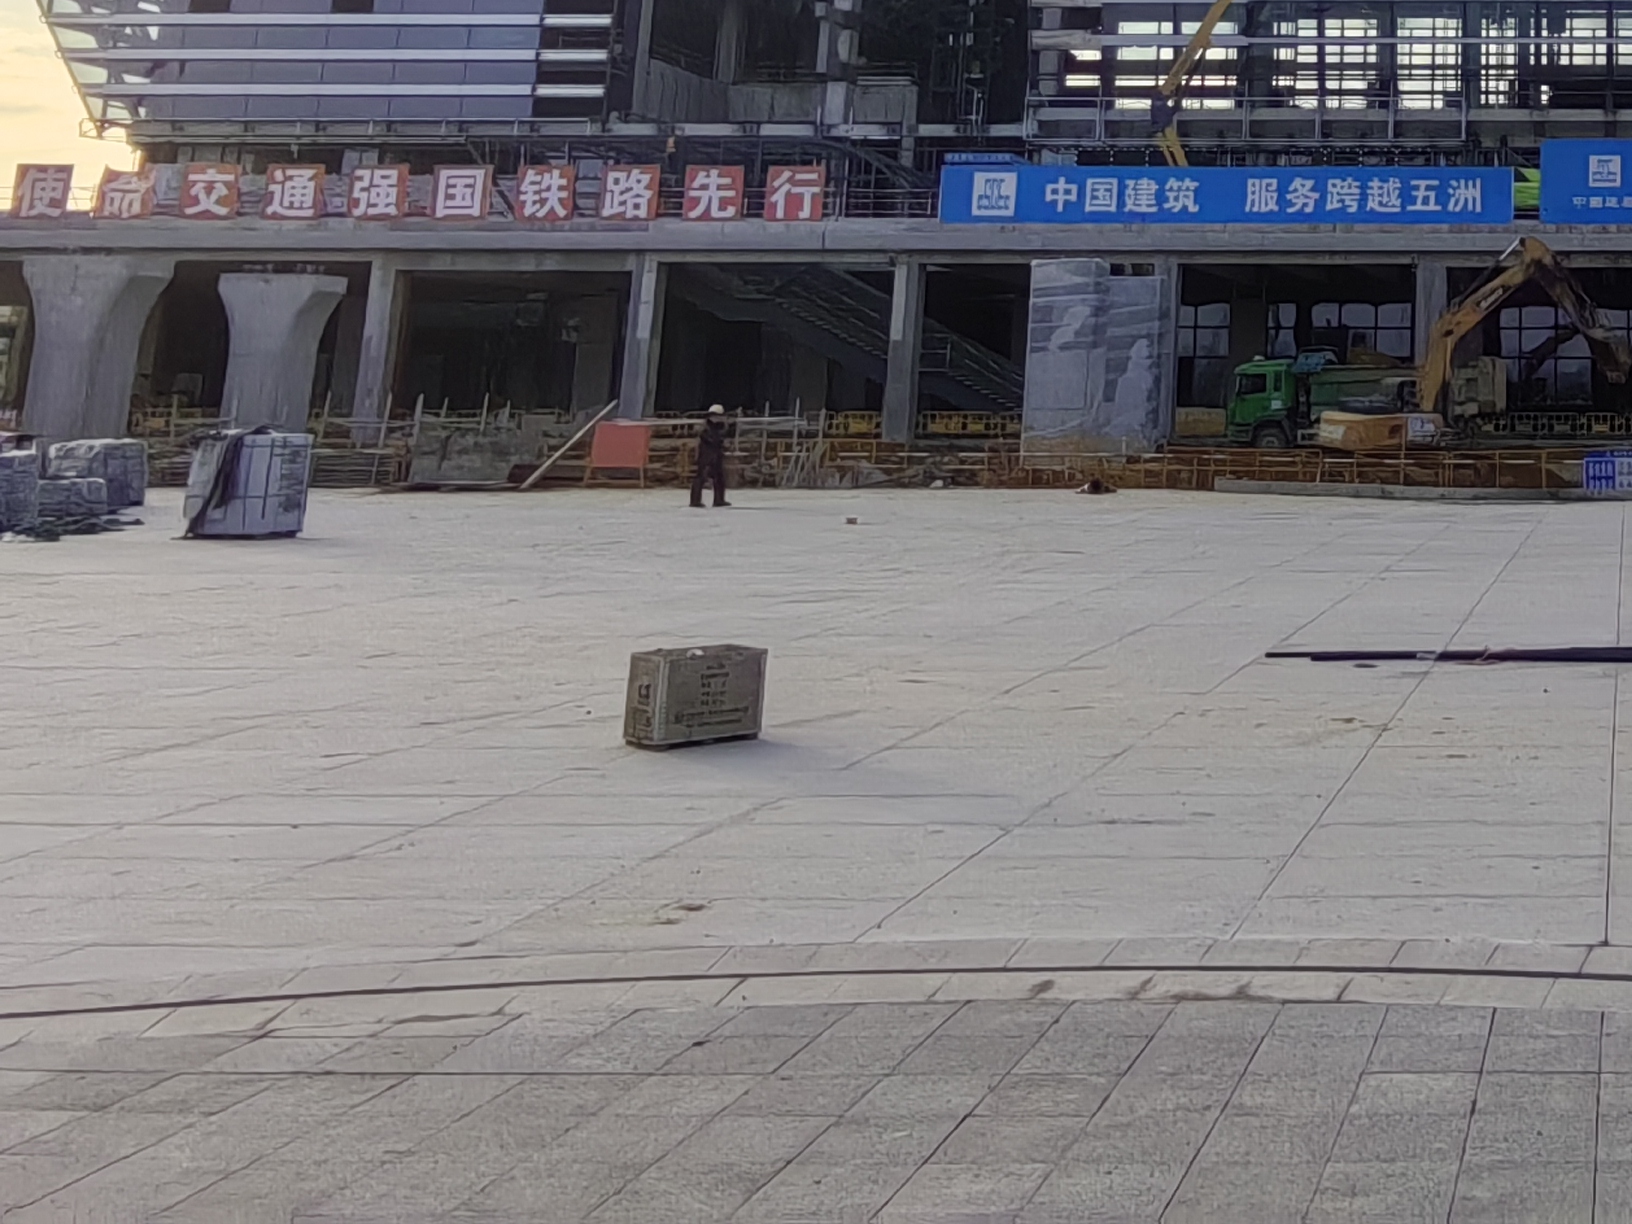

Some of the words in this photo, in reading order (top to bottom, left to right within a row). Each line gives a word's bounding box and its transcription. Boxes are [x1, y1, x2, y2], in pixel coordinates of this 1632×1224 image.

[1045, 176, 1200, 213] 中国建筑
[1244, 177, 1482, 213] 服务跨越五洲
